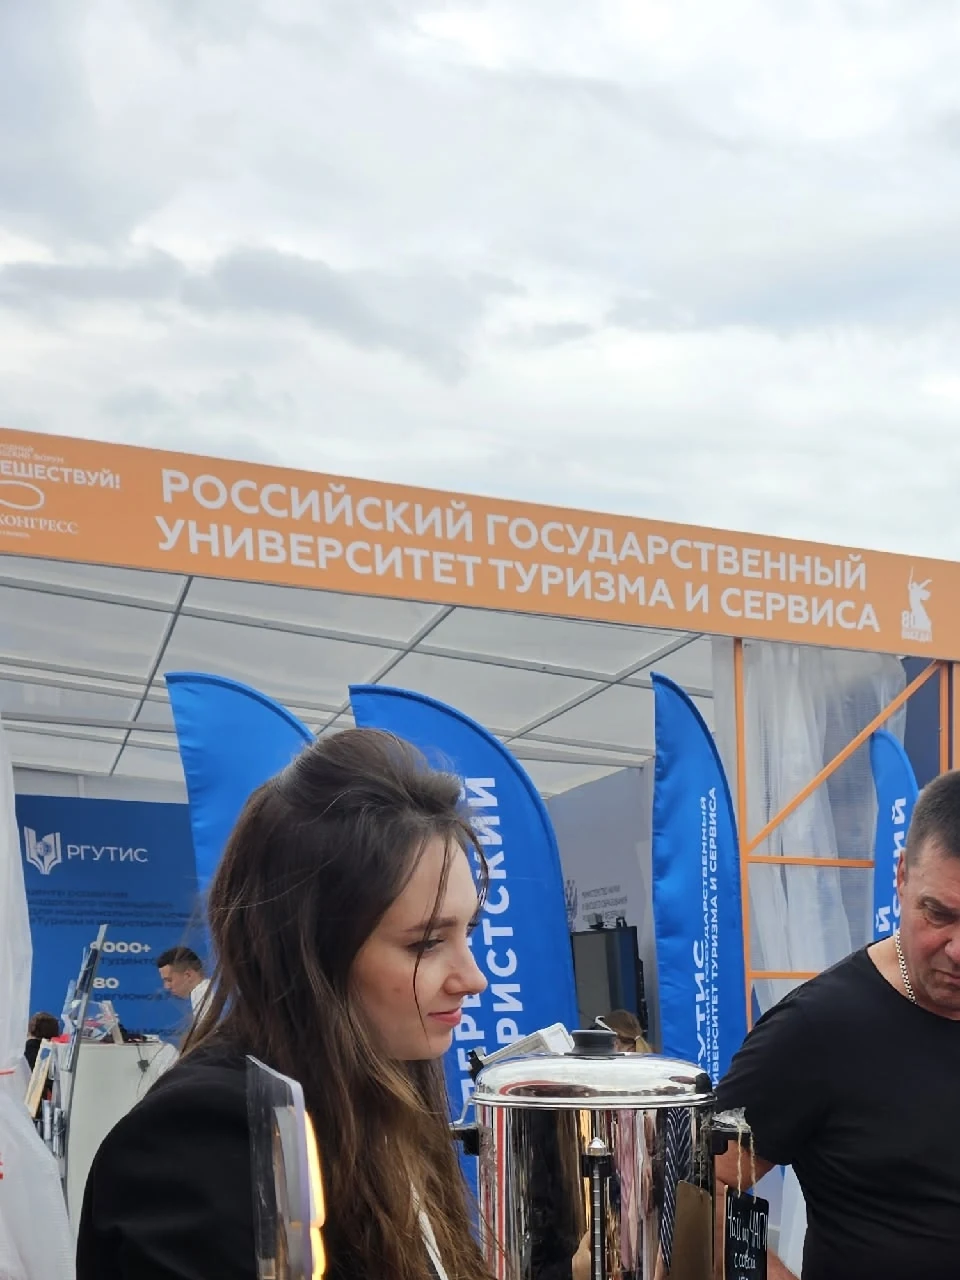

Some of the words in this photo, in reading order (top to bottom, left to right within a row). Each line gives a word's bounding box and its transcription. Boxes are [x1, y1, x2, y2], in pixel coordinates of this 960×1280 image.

[161, 467, 473, 542] РОССИЙСКИЙ
[486, 513, 867, 591] ГОСУДАРСТВЕННЫЙ
[154, 515, 482, 587] УНИВЕРСИТЕТ
[488, 558, 675, 610] ТУРИЗМА
[685, 582, 709, 614] И
[720, 587, 881, 633] СЕРВИСА
[67, 843, 149, 863] РГУТИС
[709, 786, 718, 874] СЕРВИСА
[709, 877, 718, 890] И
[709, 895, 719, 981] ТУРИЗМА
[92, 977, 119, 989] 80
